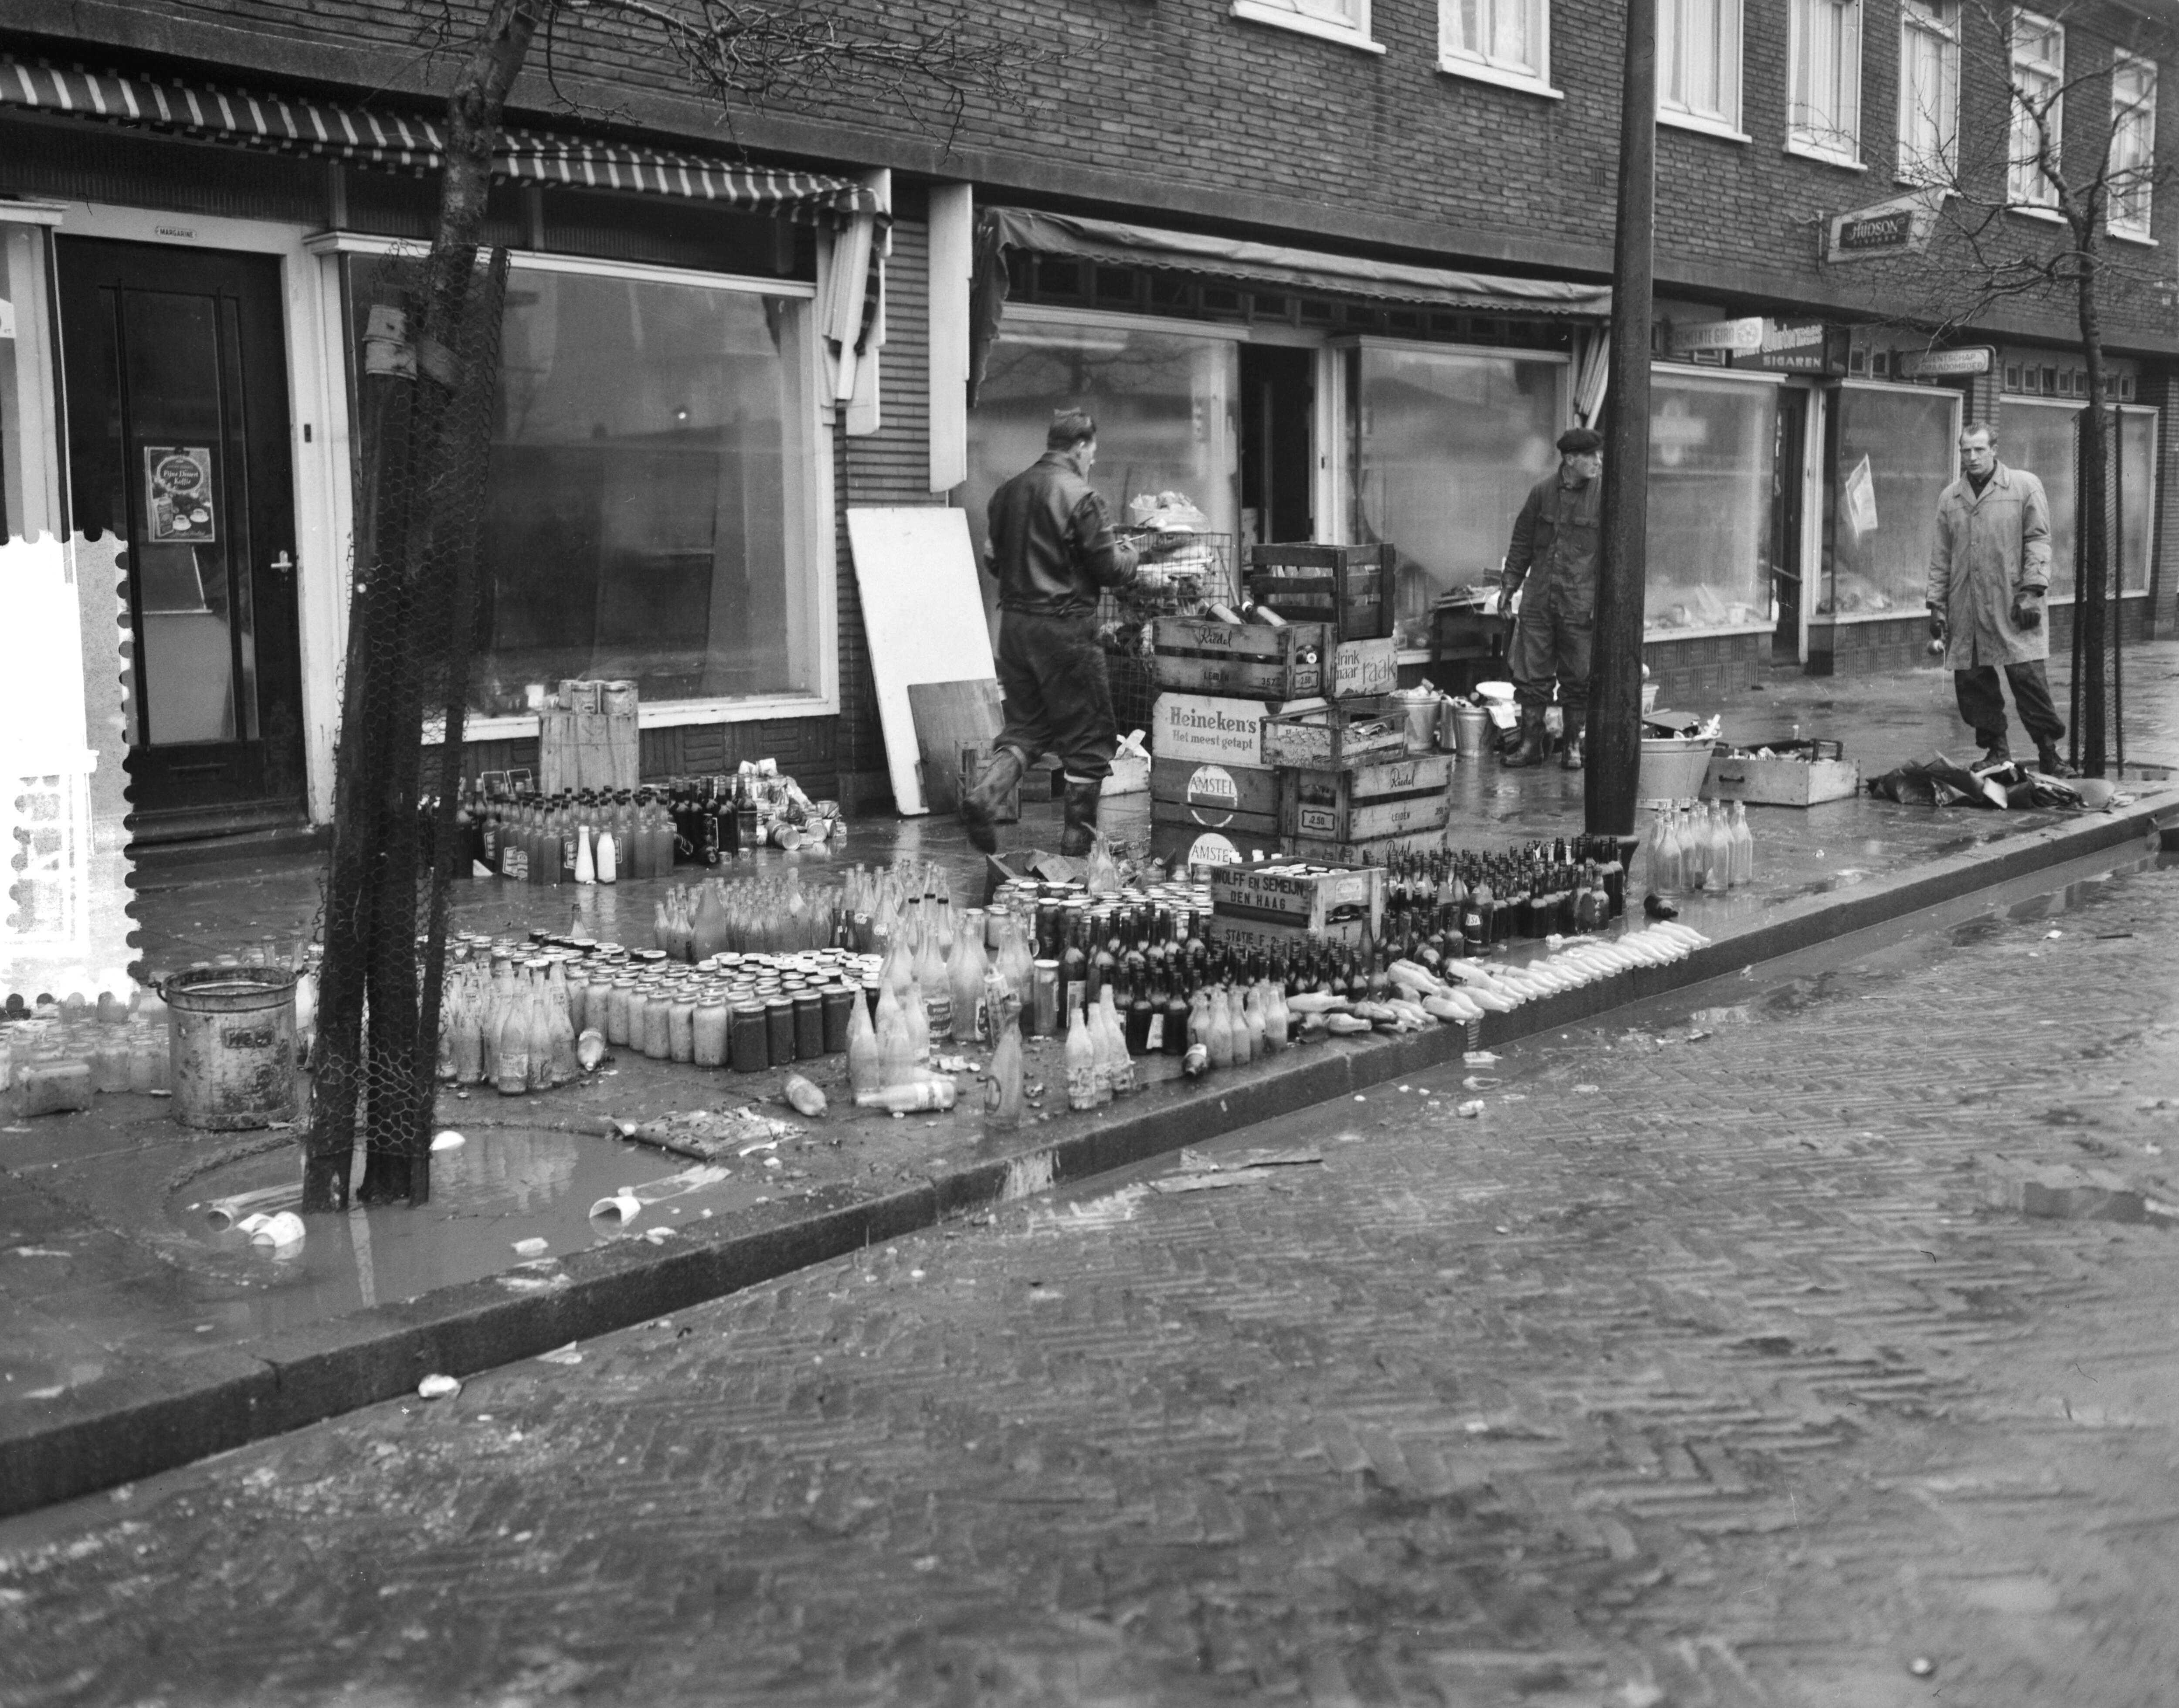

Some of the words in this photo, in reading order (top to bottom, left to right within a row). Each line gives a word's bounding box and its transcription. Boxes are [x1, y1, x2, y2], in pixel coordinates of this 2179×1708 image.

[160, 228, 193, 238] MARGARINE
[1846, 217, 1905, 241] HUDSON
[1763, 356, 1821, 367] SIGAREN
[1198, 625, 1232, 648] Riedel
[1363, 655, 1396, 685] raak
[1262, 678, 1276, 686] 357
[1170, 706, 1256, 733] Heineken's
[1173, 730, 1188, 742] Het
[1191, 735, 1219, 746] meest
[1222, 737, 1252, 750] getapt
[1190, 777, 1234, 795] AMSTEL
[1391, 768, 1415, 788] Riedel
[1309, 815, 1324, 825] 2.50
[1392, 812, 1410, 822] LEIDEN
[1191, 845, 1232, 863] AMSTE
[1213, 869, 1246, 886] WOLFF
[1248, 877, 1259, 889] EN
[1263, 876, 1303, 896] SEMEIJN
[1231, 890, 1250, 904] DEN
[1257, 895, 1286, 910] HAAG
[1226, 929, 1253, 944] STATIE
[1342, 926, 1347, 940] T
